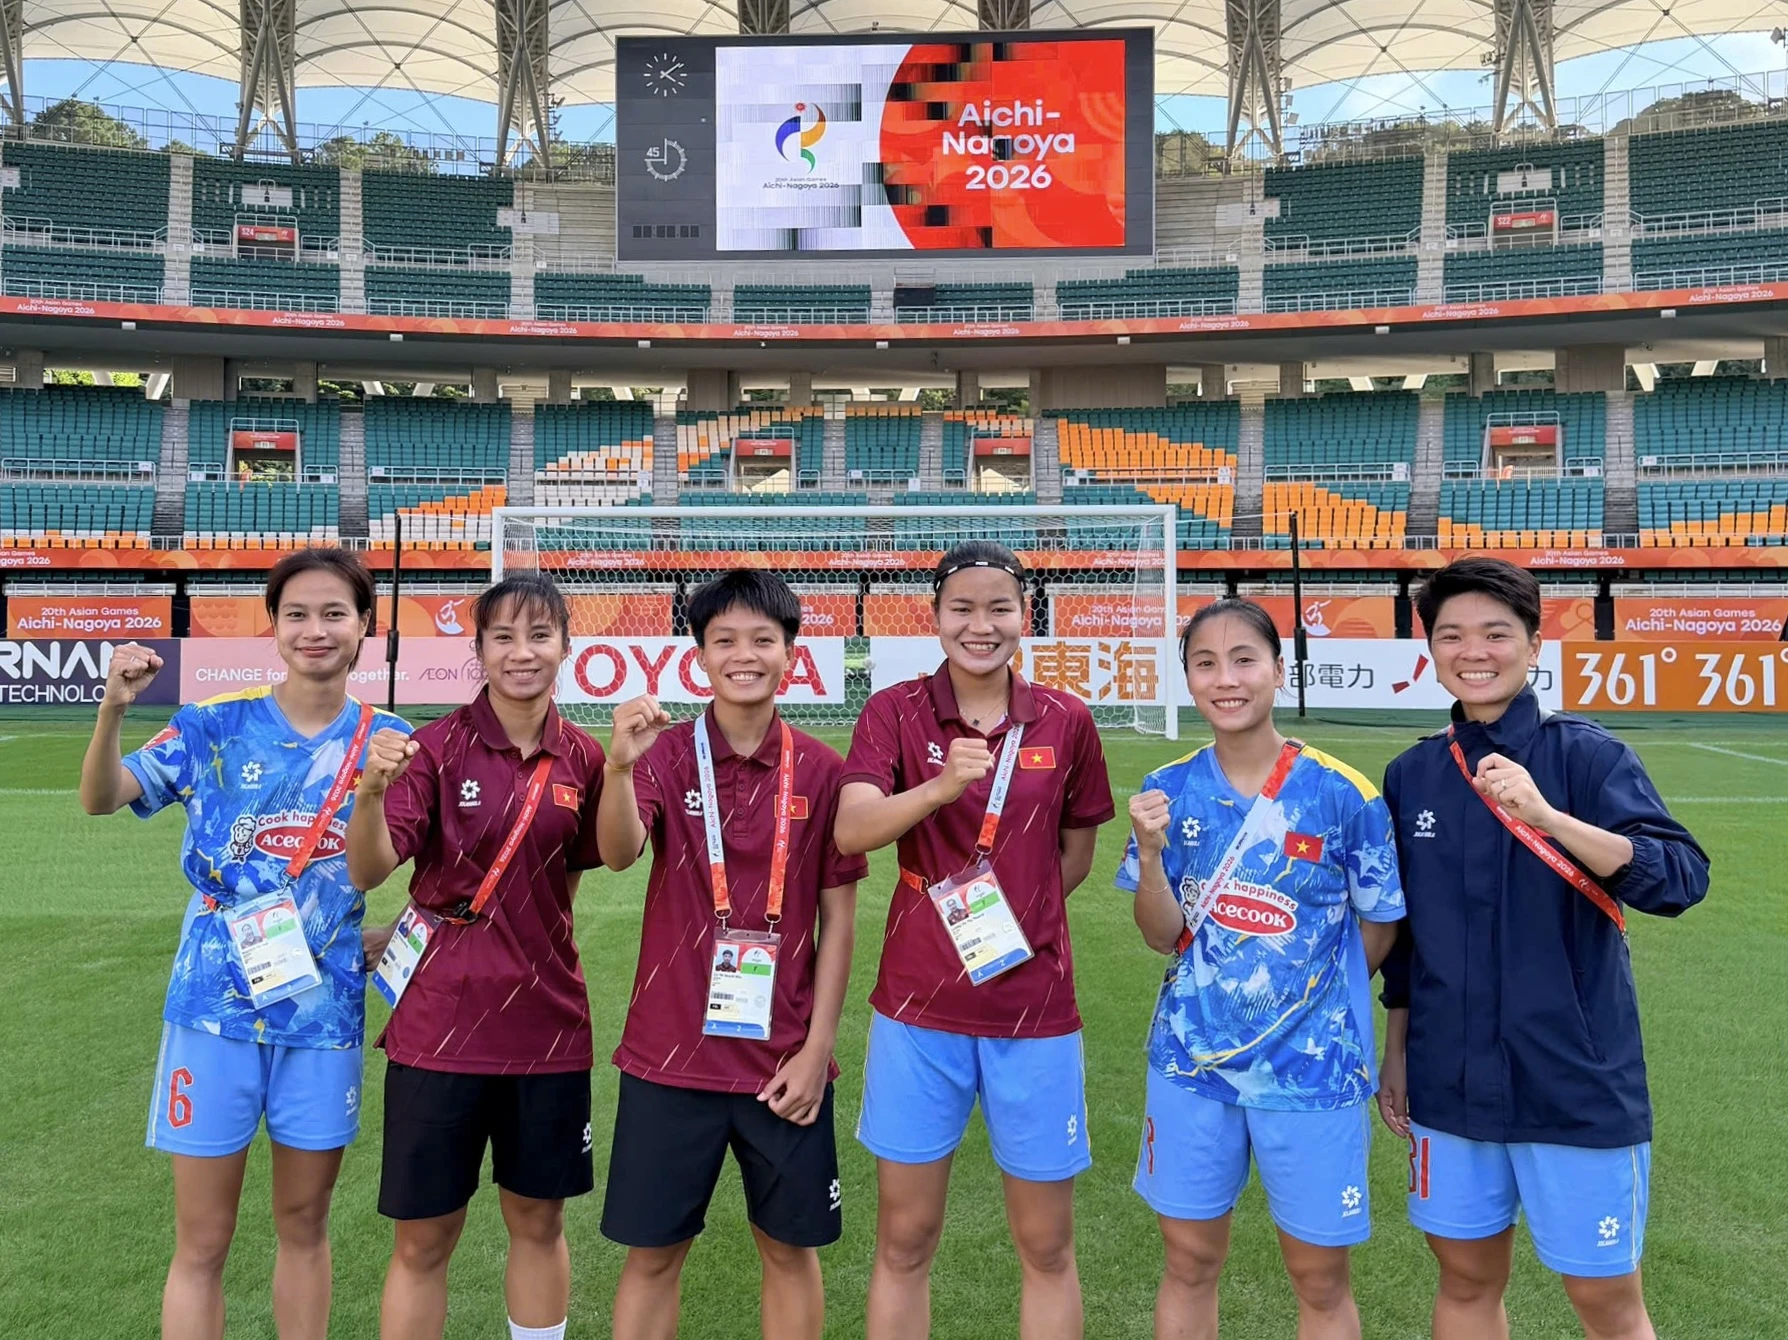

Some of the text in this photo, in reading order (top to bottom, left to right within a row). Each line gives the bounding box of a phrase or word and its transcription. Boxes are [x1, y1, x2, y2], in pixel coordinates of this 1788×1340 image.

[957, 99, 1061, 127] Aichi-
[646, 147, 660, 157] 45
[965, 164, 1052, 190] 2026
[763, 182, 817, 190] Aichi-Nagoya
[241, 227, 254, 236] S24
[1689, 290, 1774, 302] Aichi-Nagoya 2026
[17, 304, 73, 314] Aichi-Nagoya
[1422, 308, 1499, 318] Aichi-Nagoya 2026
[272, 317, 345, 327] Aichi-Nagoya 2026
[1179, 320, 1249, 330] Aichi-Nagoya 2026
[510, 326, 558, 334] Aichi-Nagoya
[733, 330, 780, 338] Aichi-Nagoya
[953, 328, 1000, 337] Aichi-Nagoya
[27, 557, 50, 565] 2026
[1530, 556, 1625, 566] Aichi-Nagoya 2026
[41, 607, 139, 616] 20th Asian Games
[1091, 605, 1113, 613] 20th
[1115, 605, 1141, 613] Asian
[1649, 608, 1757, 618] 20th Asian Games
[17, 617, 162, 631] Aichi-Nagoya 2026
[802, 614, 834, 625] 2026
[1071, 615, 1162, 628] Aichi-Nagoya
[1625, 619, 1782, 634] Aichi-Nagoya 2026
[196, 668, 263, 682] CHANGE
[348, 668, 410, 684] ogether.
[549, 644, 827, 697] OYOA
[1012, 641, 1159, 701] 東海
[1575, 647, 1677, 705] 361°
[1001, 740, 1016, 780] Aichi-Nagoya
[331, 743, 360, 801] Aichi-Nagoya 2026
[781, 774, 790, 816] Aichi-Nagoya
[707, 783, 716, 828] Aichi-Nagoya
[258, 812, 288, 826] Cook
[509, 804, 533, 847] Aichi-Nagoya
[1516, 825, 1575, 877] Aichi-Nagoya 2026
[1201, 873, 1225, 909] Aichi-Nagoya
[1223, 856, 1235, 872] 2026
[1234, 880, 1296, 910] happiness
[168, 1065, 194, 1129] 6
